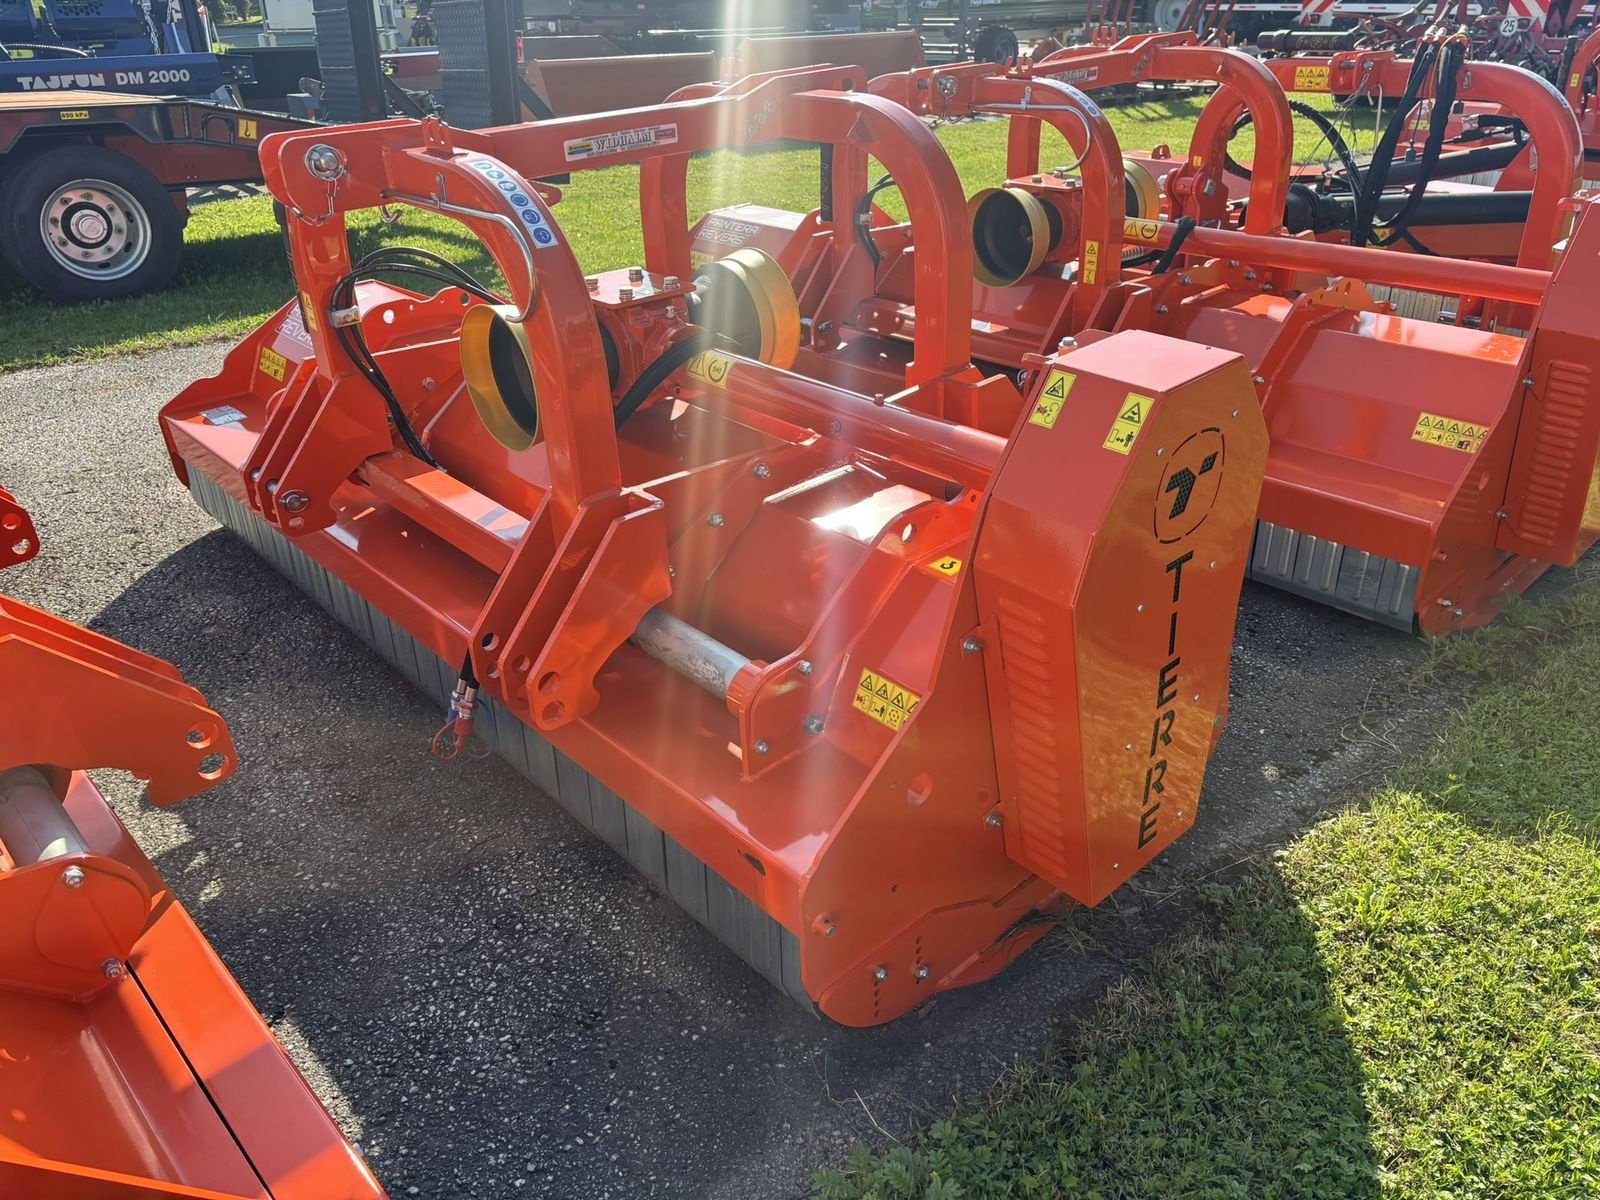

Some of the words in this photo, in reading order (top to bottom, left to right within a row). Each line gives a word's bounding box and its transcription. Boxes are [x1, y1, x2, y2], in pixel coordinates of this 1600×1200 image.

[1502, 20, 1516, 33] 25
[16, 73, 106, 90] TAJFUN
[115, 71, 144, 86] DM
[149, 68, 191, 84] 2000
[706, 218, 760, 235] PANTERA
[698, 228, 745, 244] REVERS
[1137, 550, 1194, 850] TIERRE
